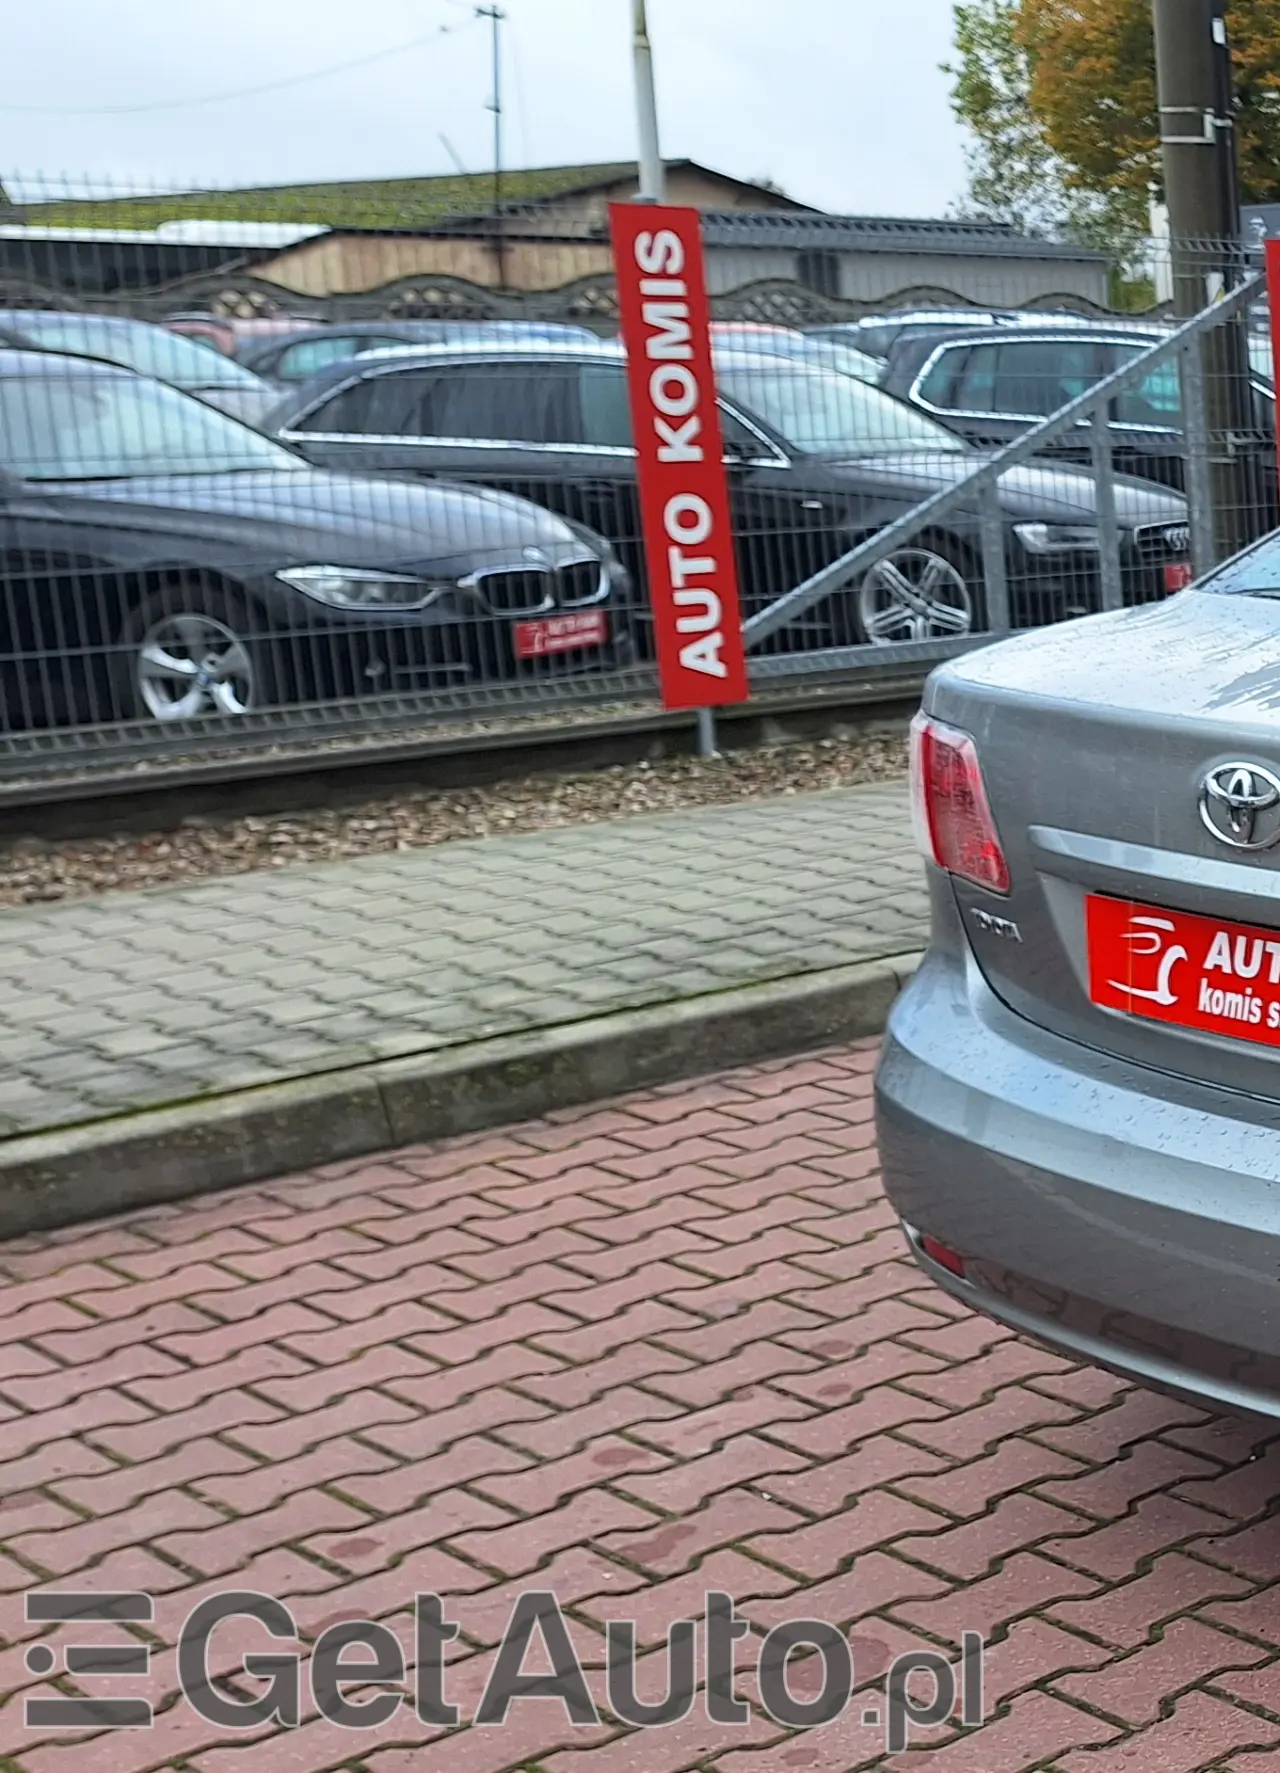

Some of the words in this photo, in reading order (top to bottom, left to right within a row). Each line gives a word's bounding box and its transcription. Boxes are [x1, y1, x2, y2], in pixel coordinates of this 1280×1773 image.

[633, 228, 704, 463] KOMIS
[663, 492, 728, 678] AUTO
[1198, 979, 1262, 1024] komis
